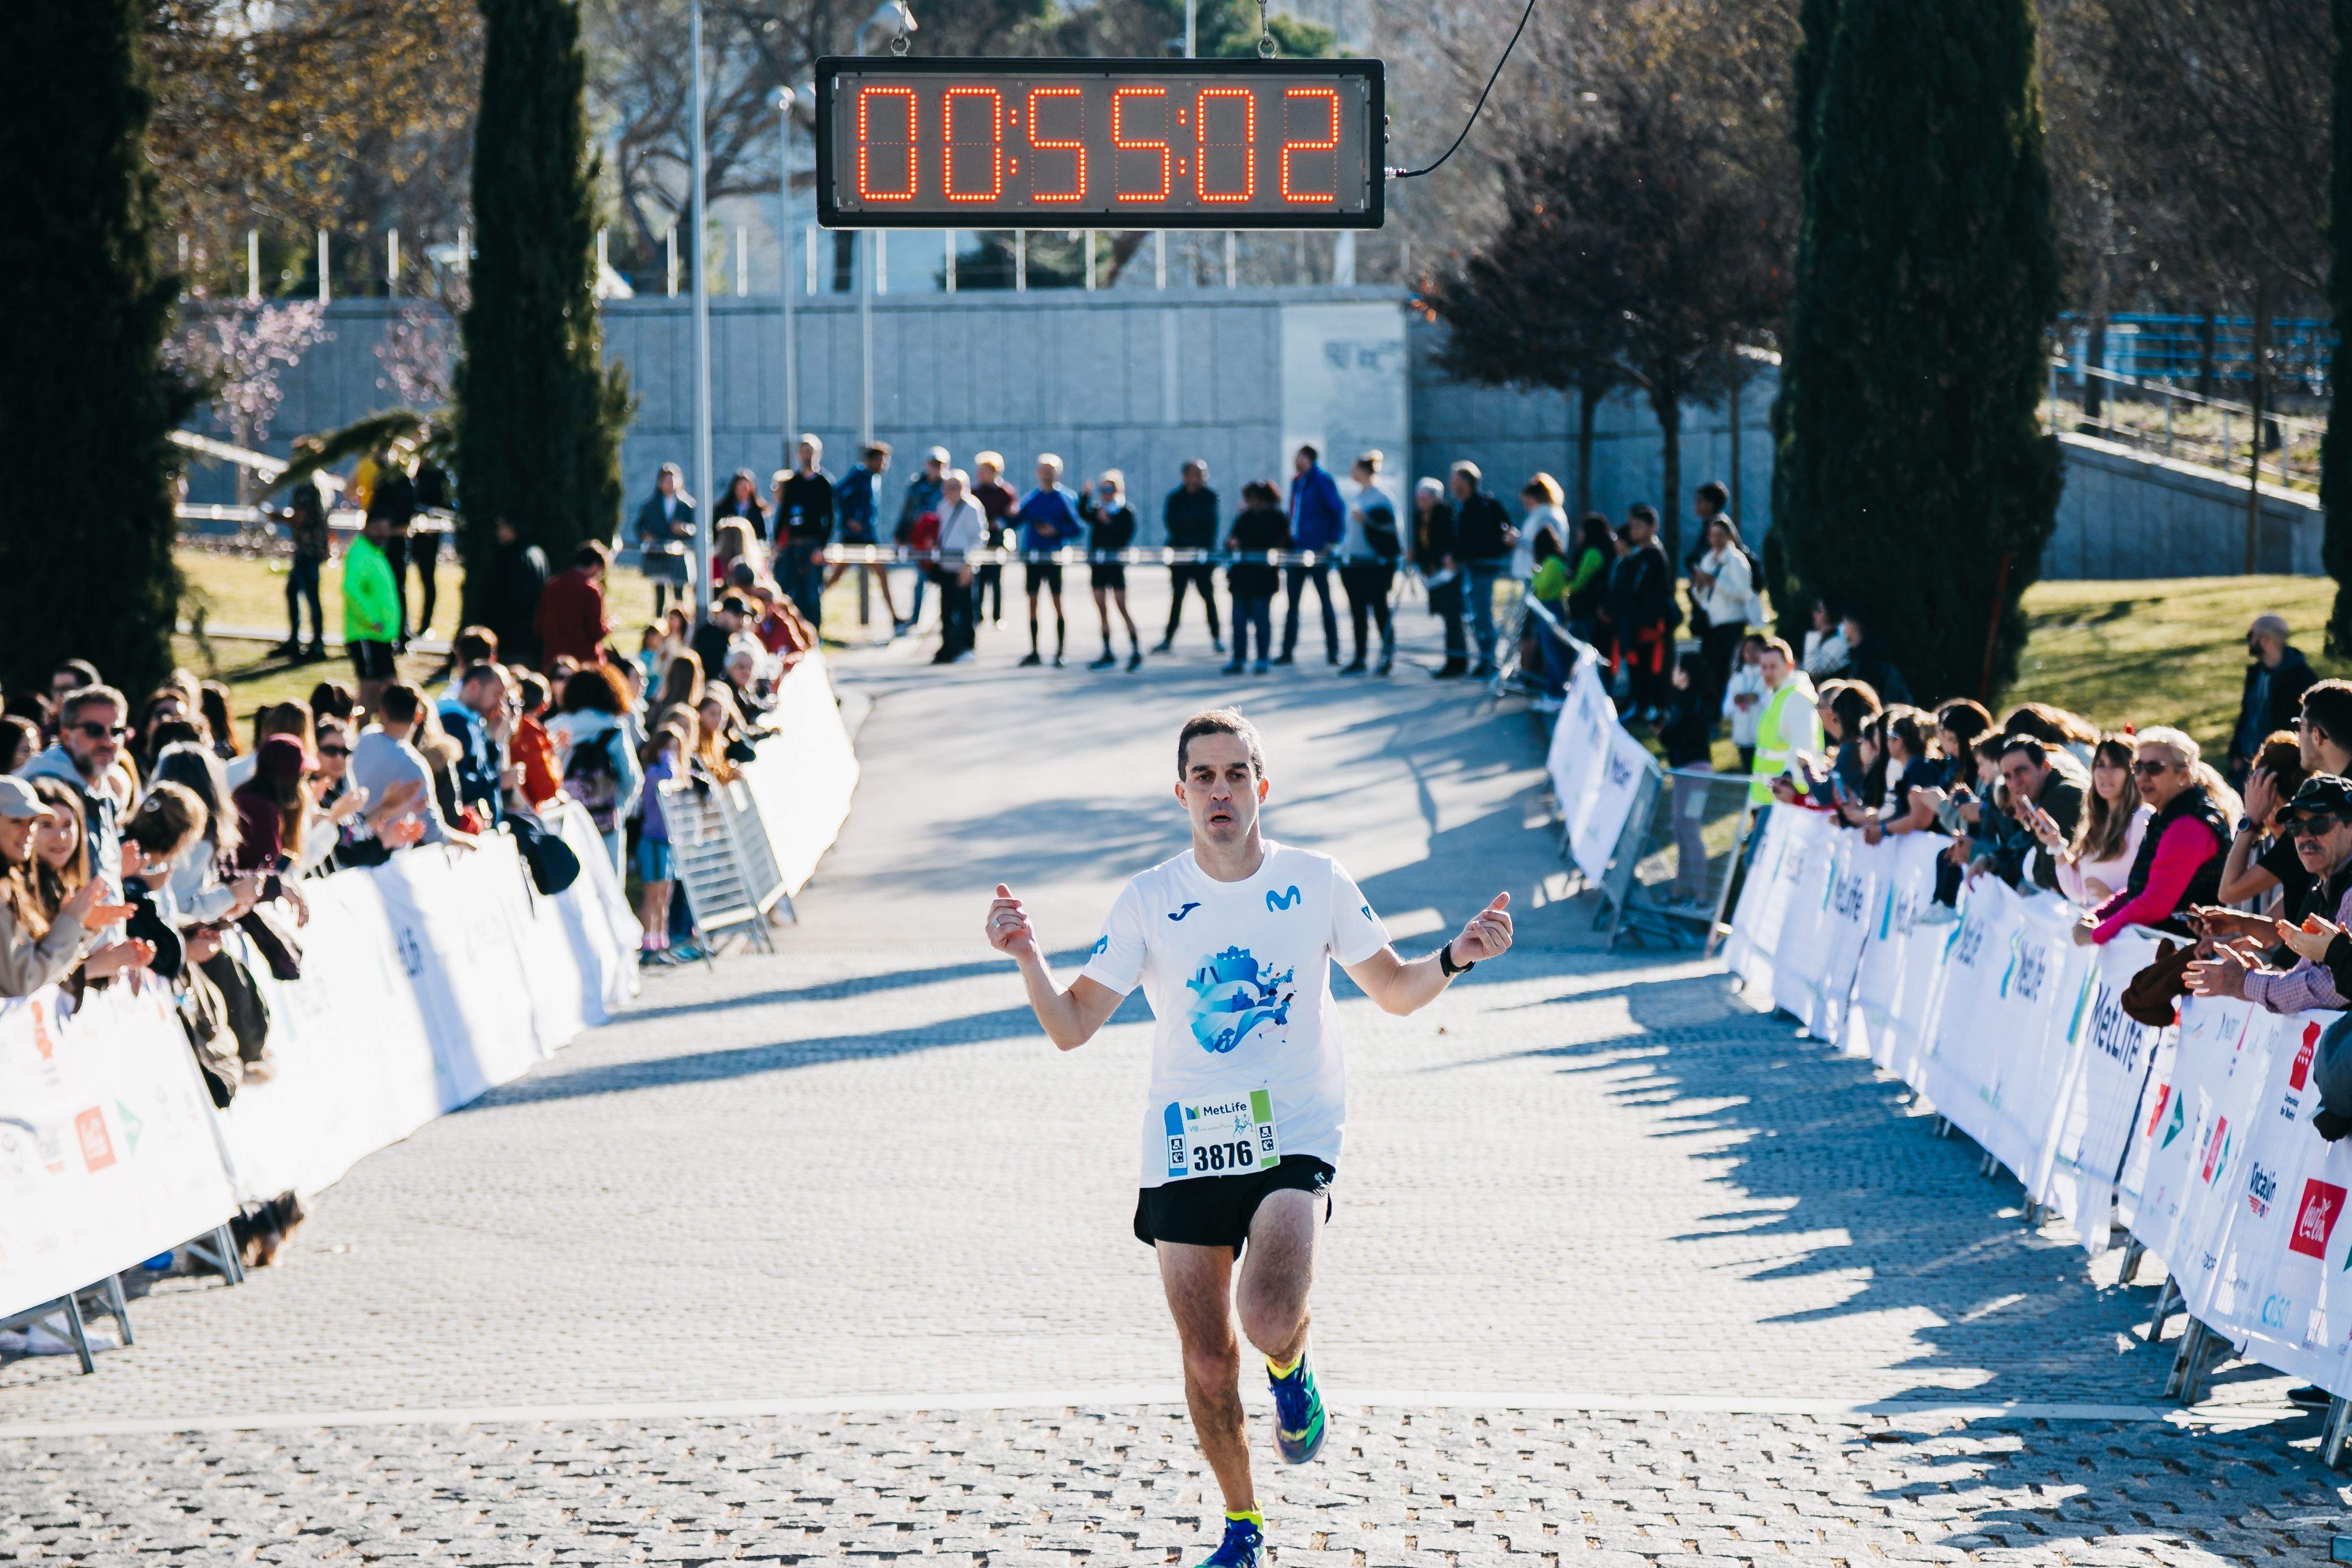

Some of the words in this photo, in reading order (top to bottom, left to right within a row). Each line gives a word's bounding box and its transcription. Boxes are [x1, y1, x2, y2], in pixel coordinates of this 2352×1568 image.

[858, 87, 1339, 202] 00:55:02
[2085, 982, 2142, 1073] MetLife
[1203, 1102, 1247, 1116] MetLife
[1193, 1140, 1253, 1171] 3876
